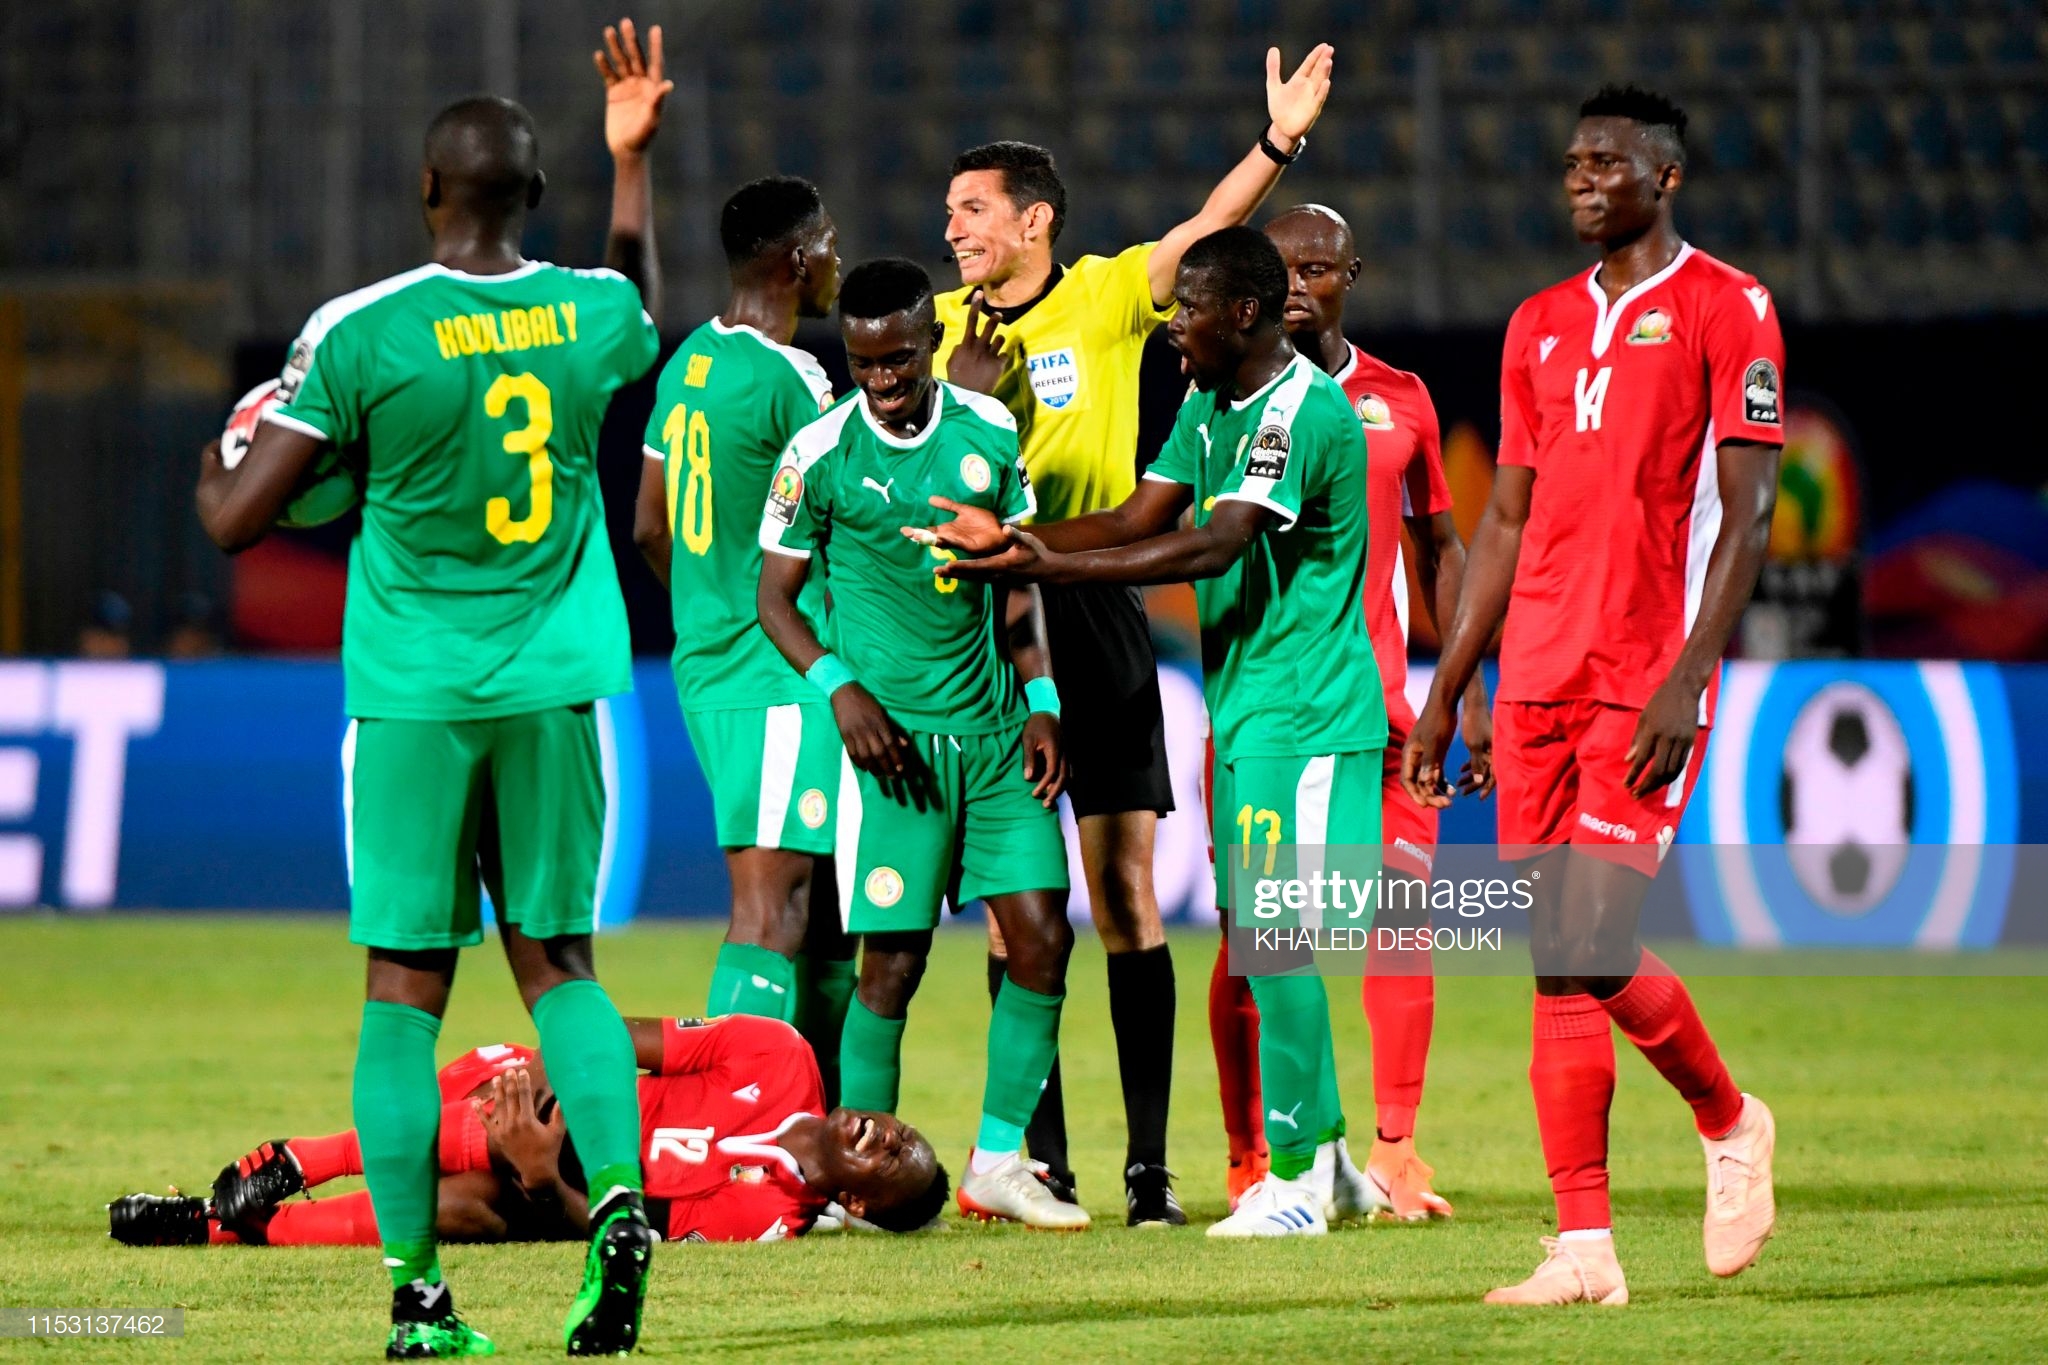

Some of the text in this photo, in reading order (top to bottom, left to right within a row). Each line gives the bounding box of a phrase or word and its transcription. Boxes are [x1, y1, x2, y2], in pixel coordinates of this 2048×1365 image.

[434, 301, 577, 360] KOULIBALY
[1031, 353, 1070, 372] FIFA
[1035, 375, 1074, 388] REFEREE
[1050, 396, 1068, 405] 2019
[1574, 366, 1613, 432] 14
[484, 372, 553, 545] 3
[662, 403, 713, 556] 18
[1237, 804, 1282, 875] 17
[1580, 811, 1637, 843] macron
[649, 1126, 715, 1163] 12
